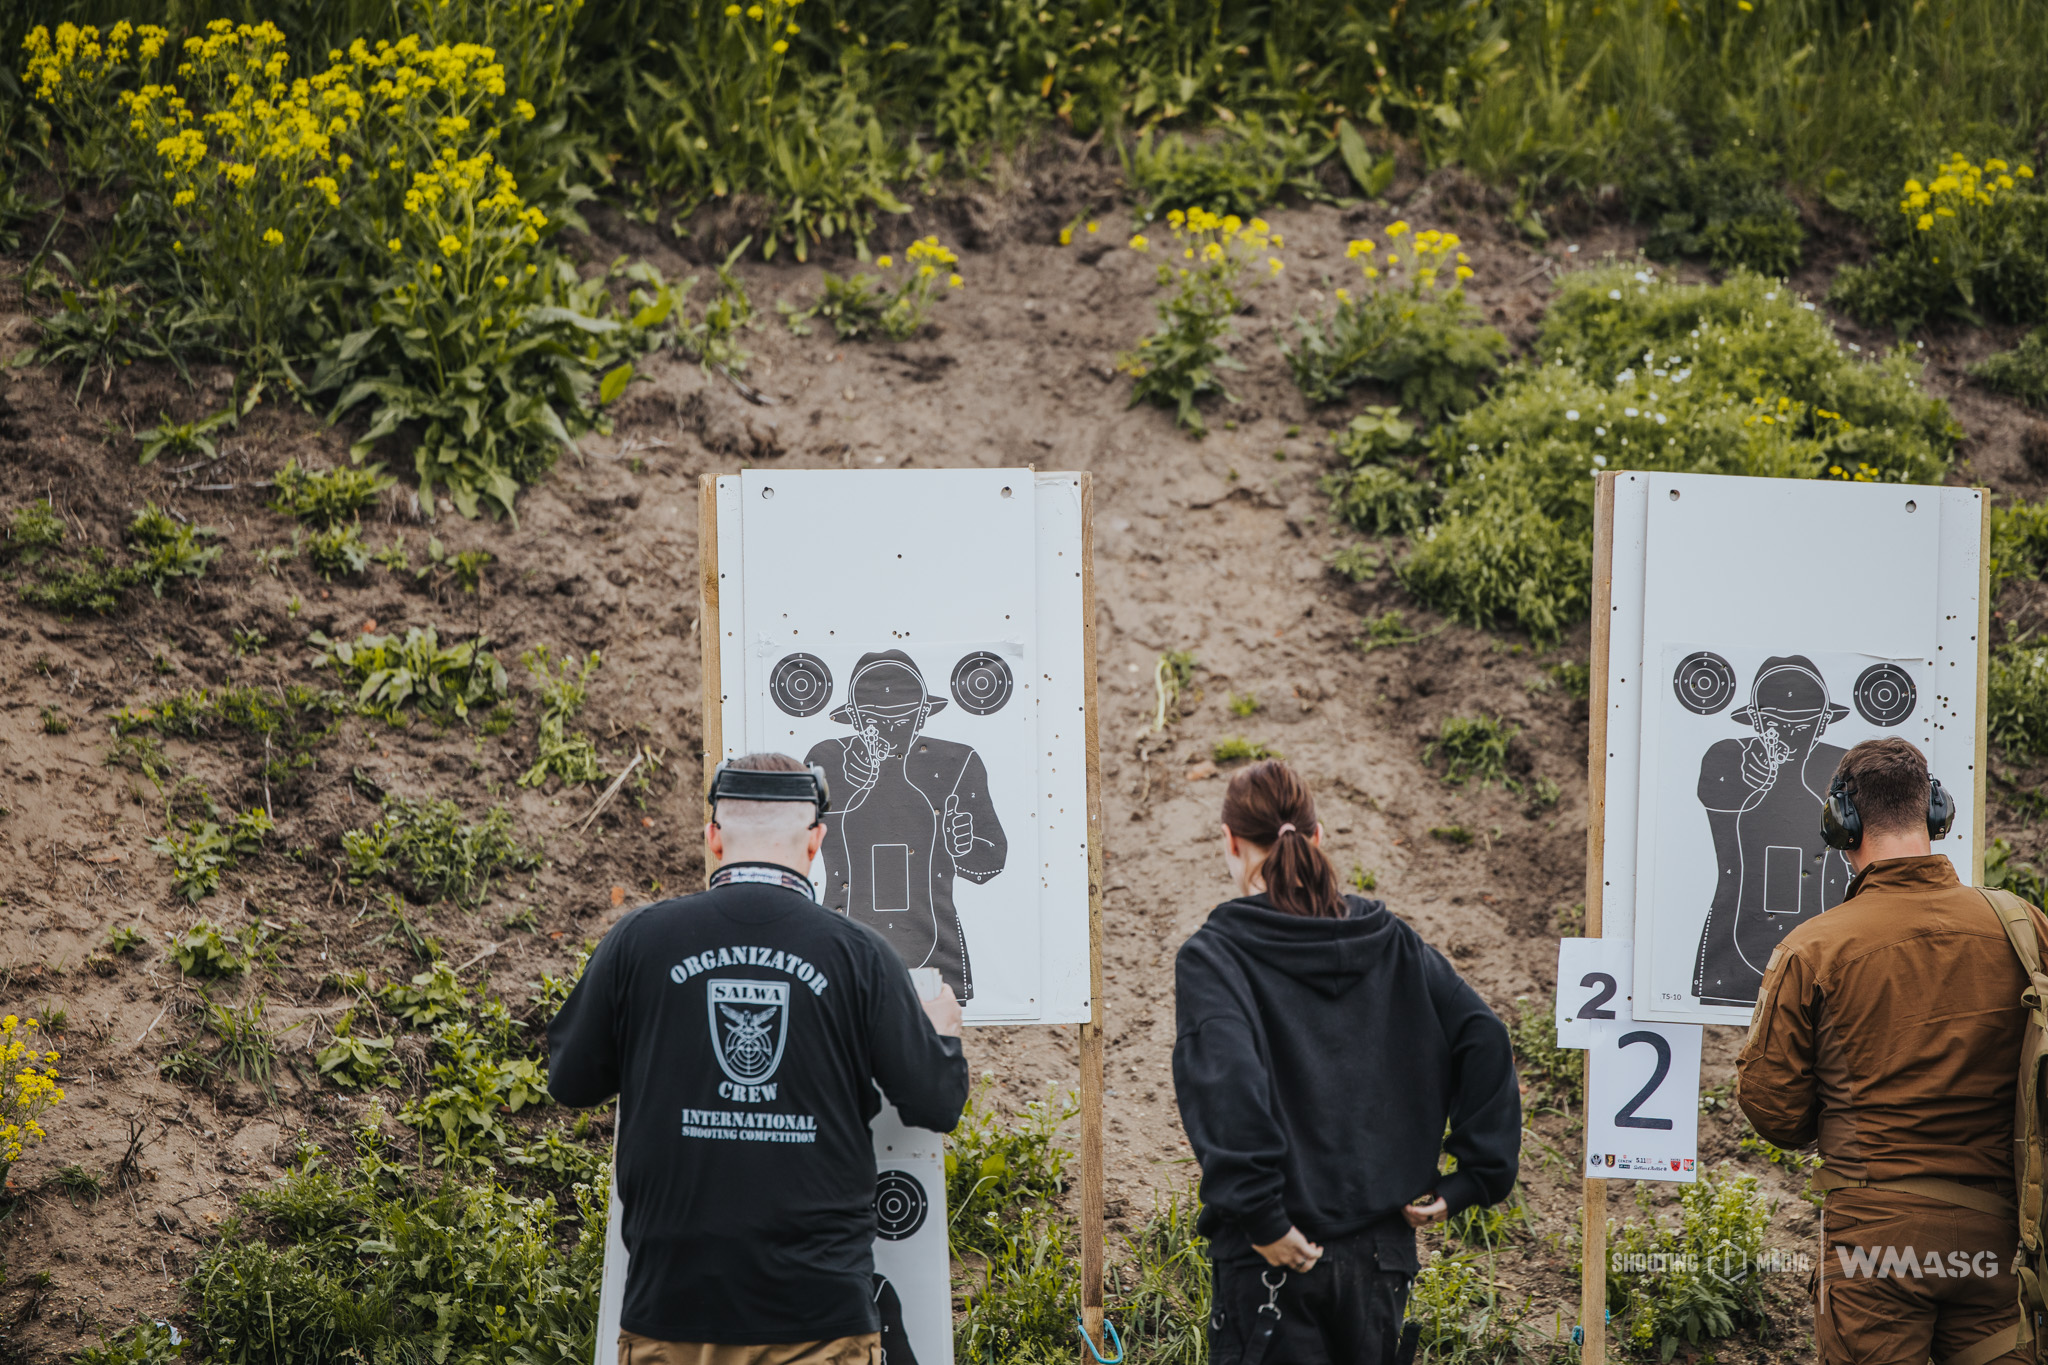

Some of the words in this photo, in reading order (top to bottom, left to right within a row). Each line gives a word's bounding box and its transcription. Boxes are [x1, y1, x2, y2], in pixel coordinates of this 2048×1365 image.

[670, 946, 829, 996] ORGANIZATOR
[714, 986, 782, 1002] SALWA
[1576, 972, 1617, 1020] 2
[1662, 993, 1682, 1001] TS-10
[1614, 1030, 1673, 1131] 2
[717, 1081, 778, 1103] CREW
[682, 1109, 817, 1131] INTERNATIONAL
[682, 1126, 738, 1141] SHOOTING
[739, 1129, 816, 1143] COMPETITION
